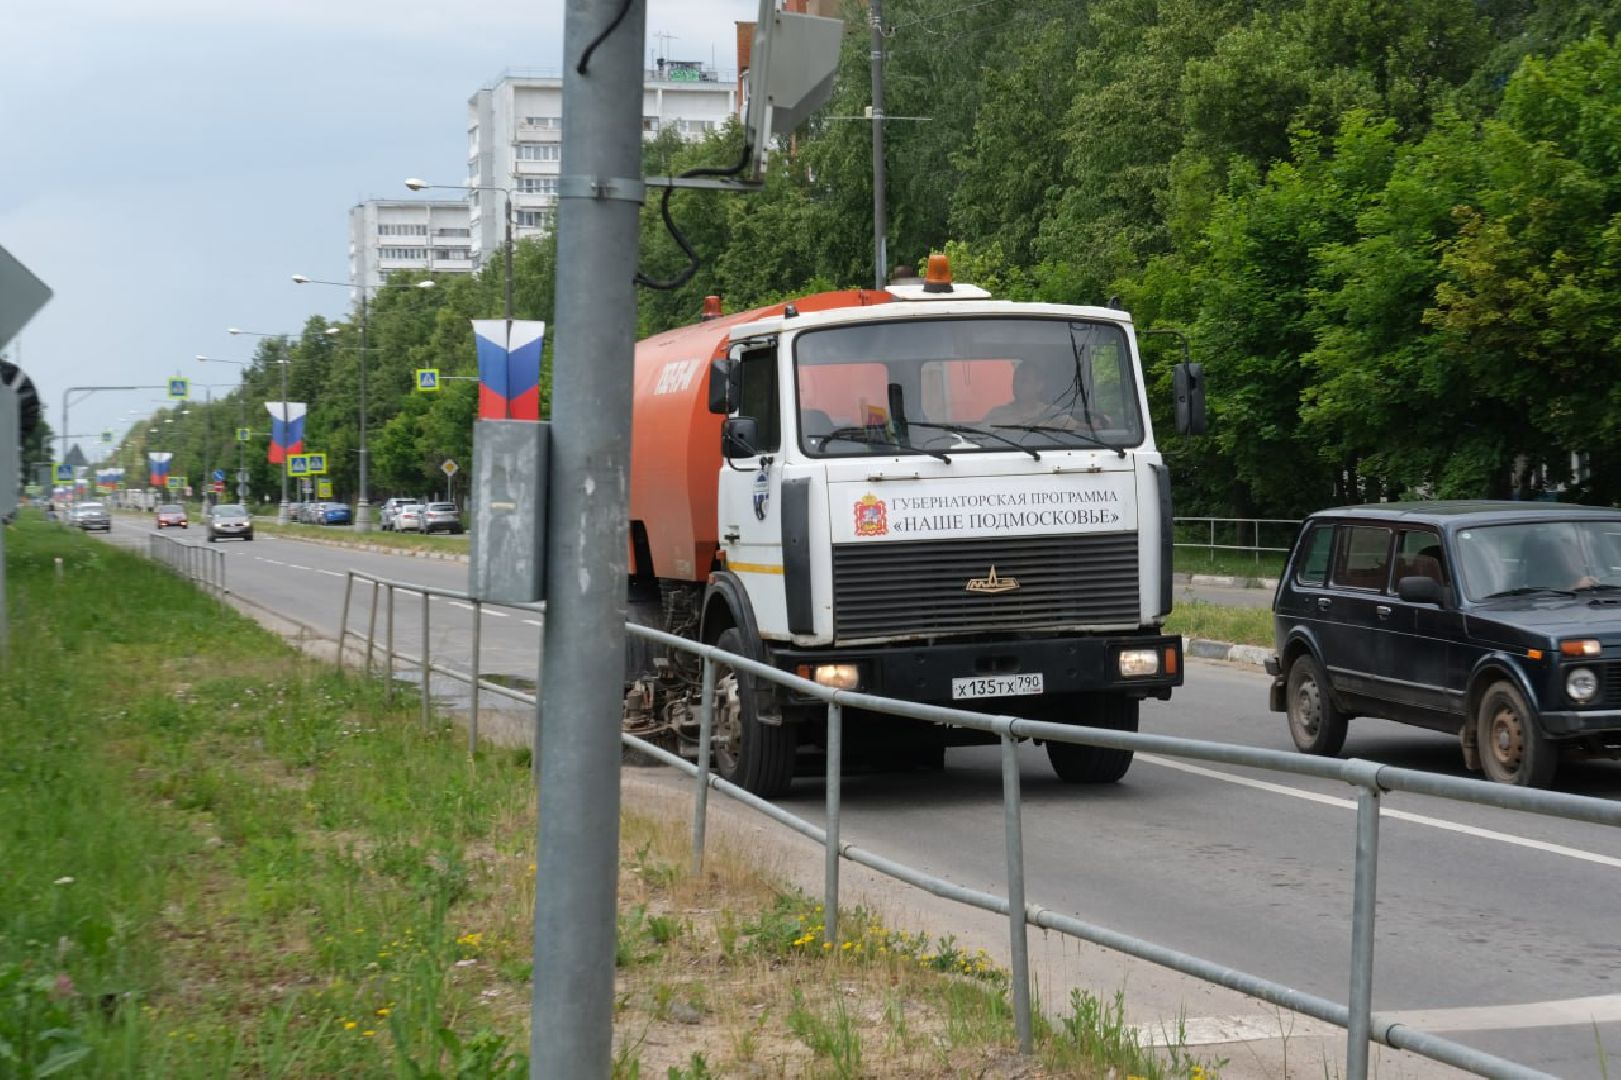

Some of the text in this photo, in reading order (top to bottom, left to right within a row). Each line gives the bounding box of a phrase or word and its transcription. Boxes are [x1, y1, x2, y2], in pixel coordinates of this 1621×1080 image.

[891, 489, 1119, 511] ГУБЕРНАТОРСКАЯ ПРОГРАММА
[894, 508, 1119, 532] «НАШЕ ПОДМОСКОВЬЕ»
